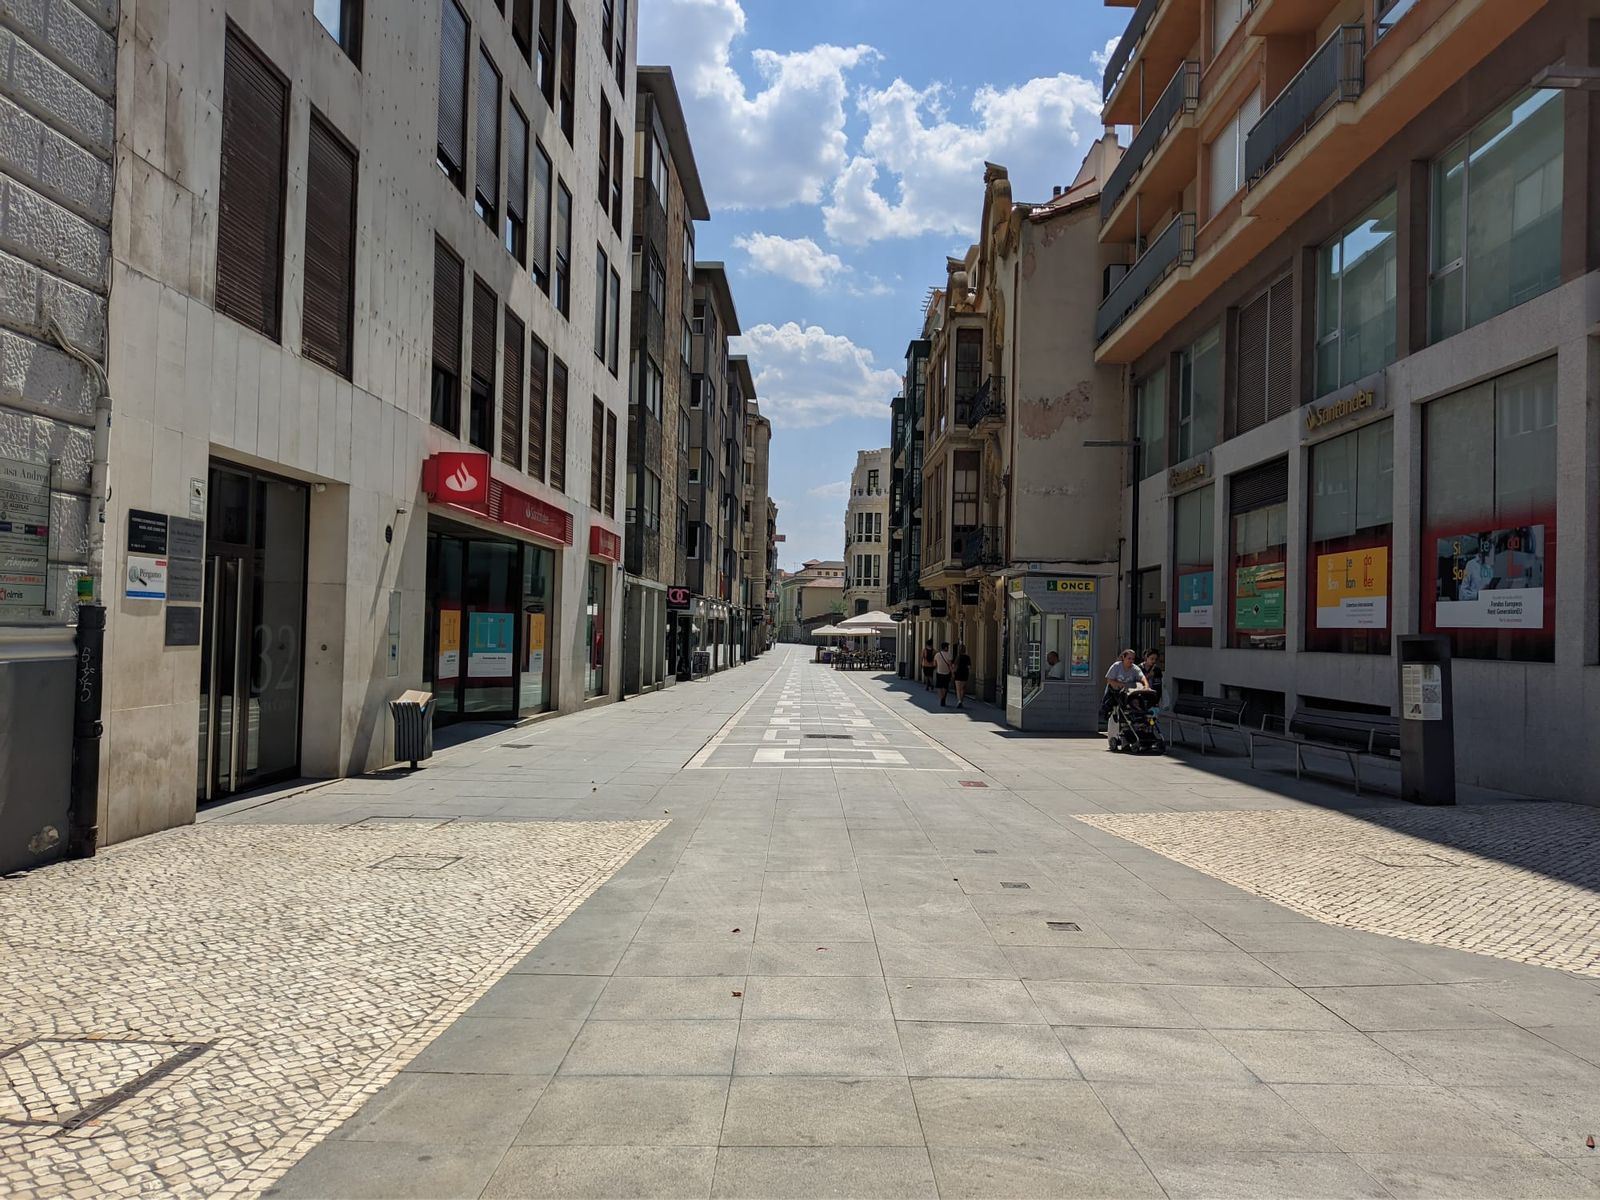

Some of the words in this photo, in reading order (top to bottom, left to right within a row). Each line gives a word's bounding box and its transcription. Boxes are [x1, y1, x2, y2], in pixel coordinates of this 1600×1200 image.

[1317, 390, 1374, 426] Santander
[140, 568, 162, 579] Pergamo
[1061, 582, 1091, 590] ONCE
[251, 625, 295, 691] 32
